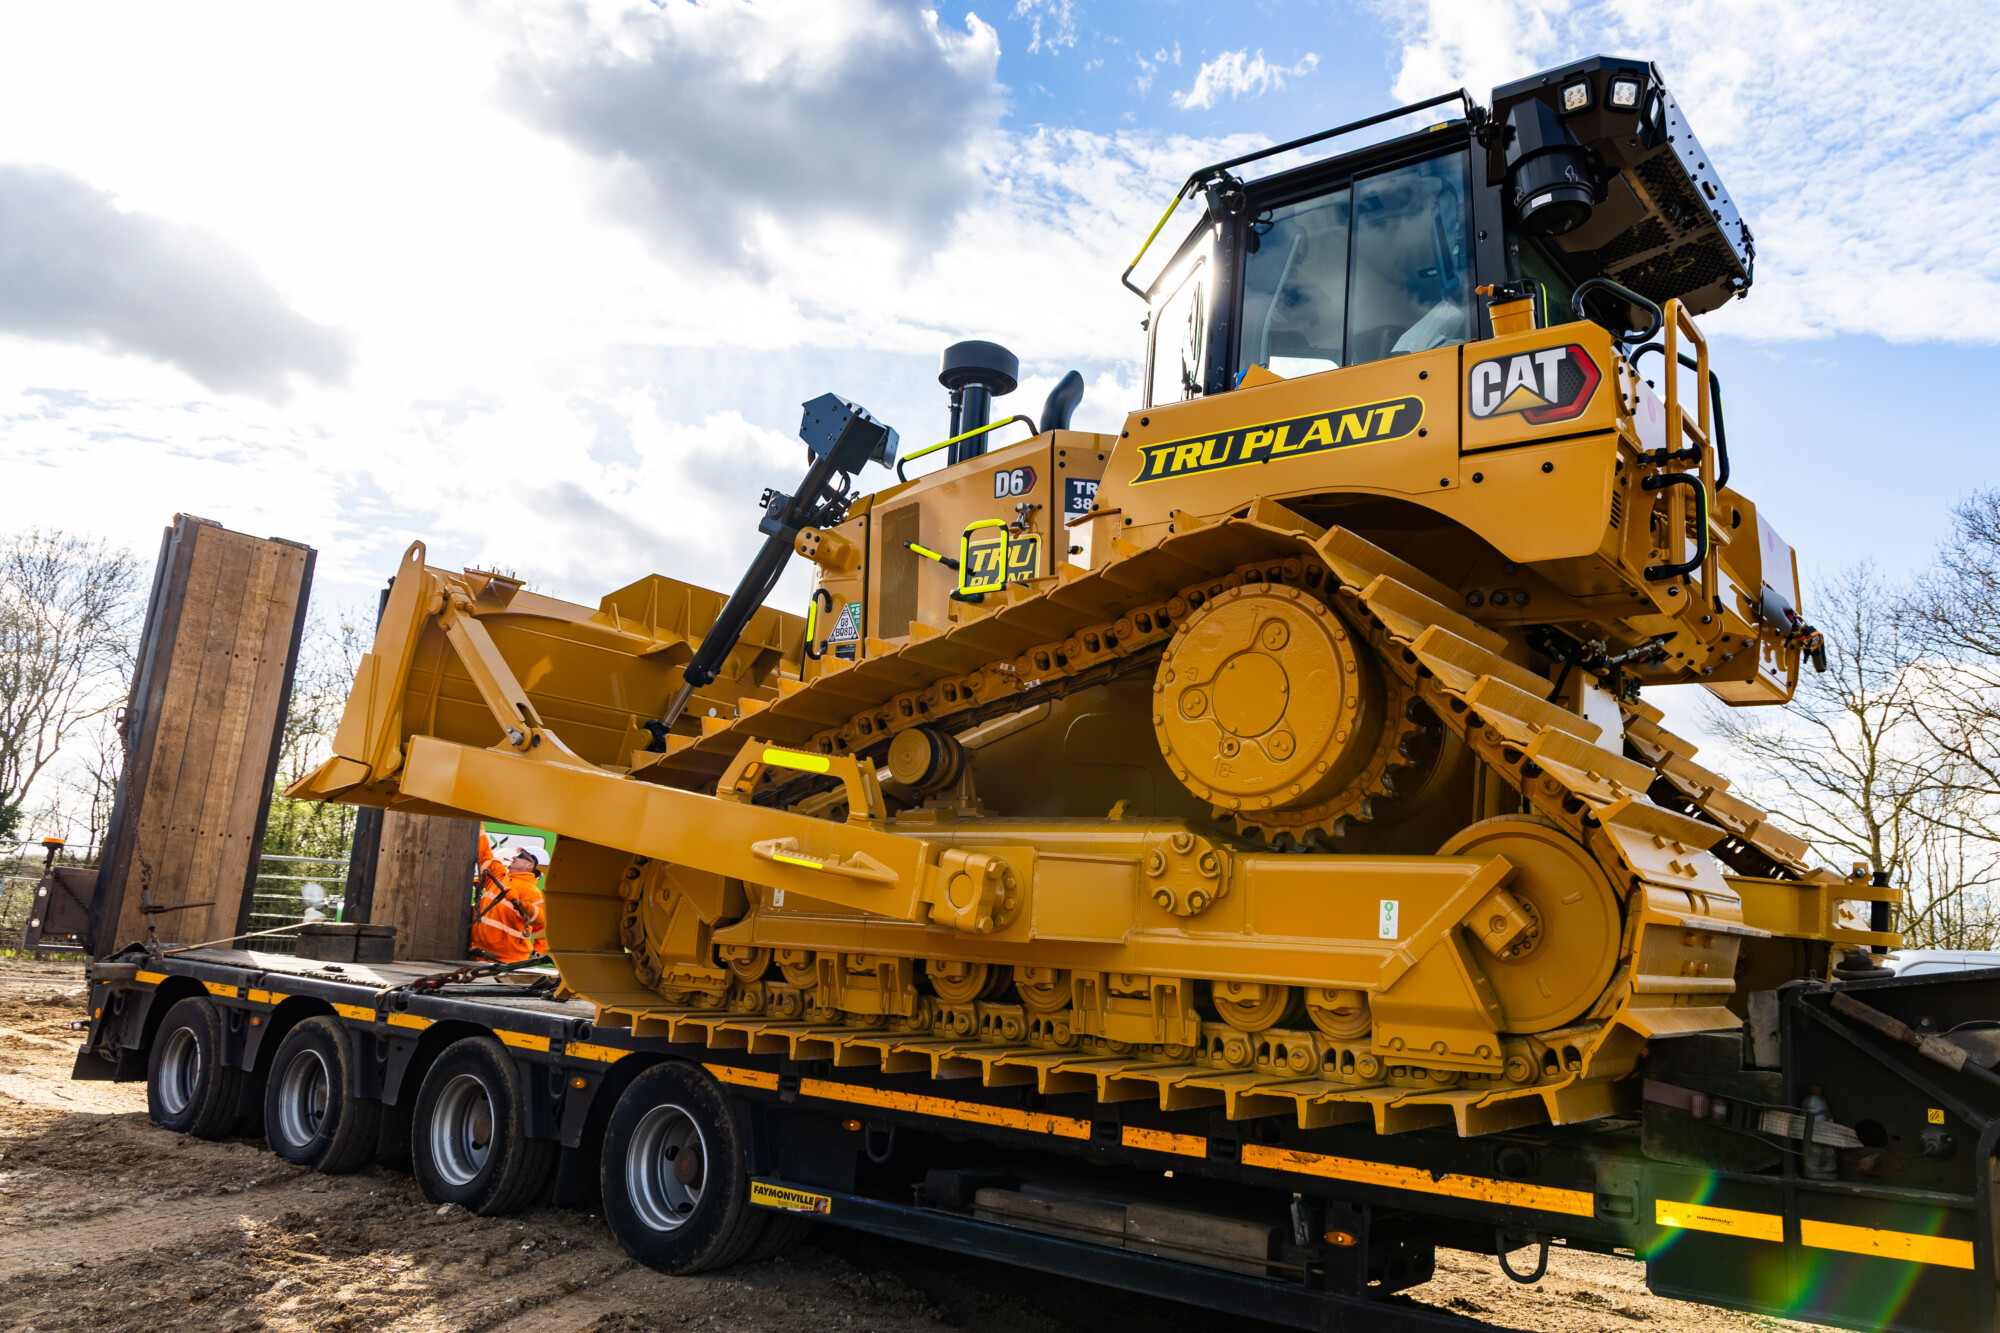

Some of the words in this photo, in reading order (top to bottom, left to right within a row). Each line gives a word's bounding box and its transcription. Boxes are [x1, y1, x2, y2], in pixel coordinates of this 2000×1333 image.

[1471, 347, 1566, 417] CAT
[1150, 435, 1235, 475] TRU
[1239, 404, 1406, 460] PLANT
[995, 469, 1024, 498] D6
[753, 1185, 815, 1206] FAYMONVILLE
